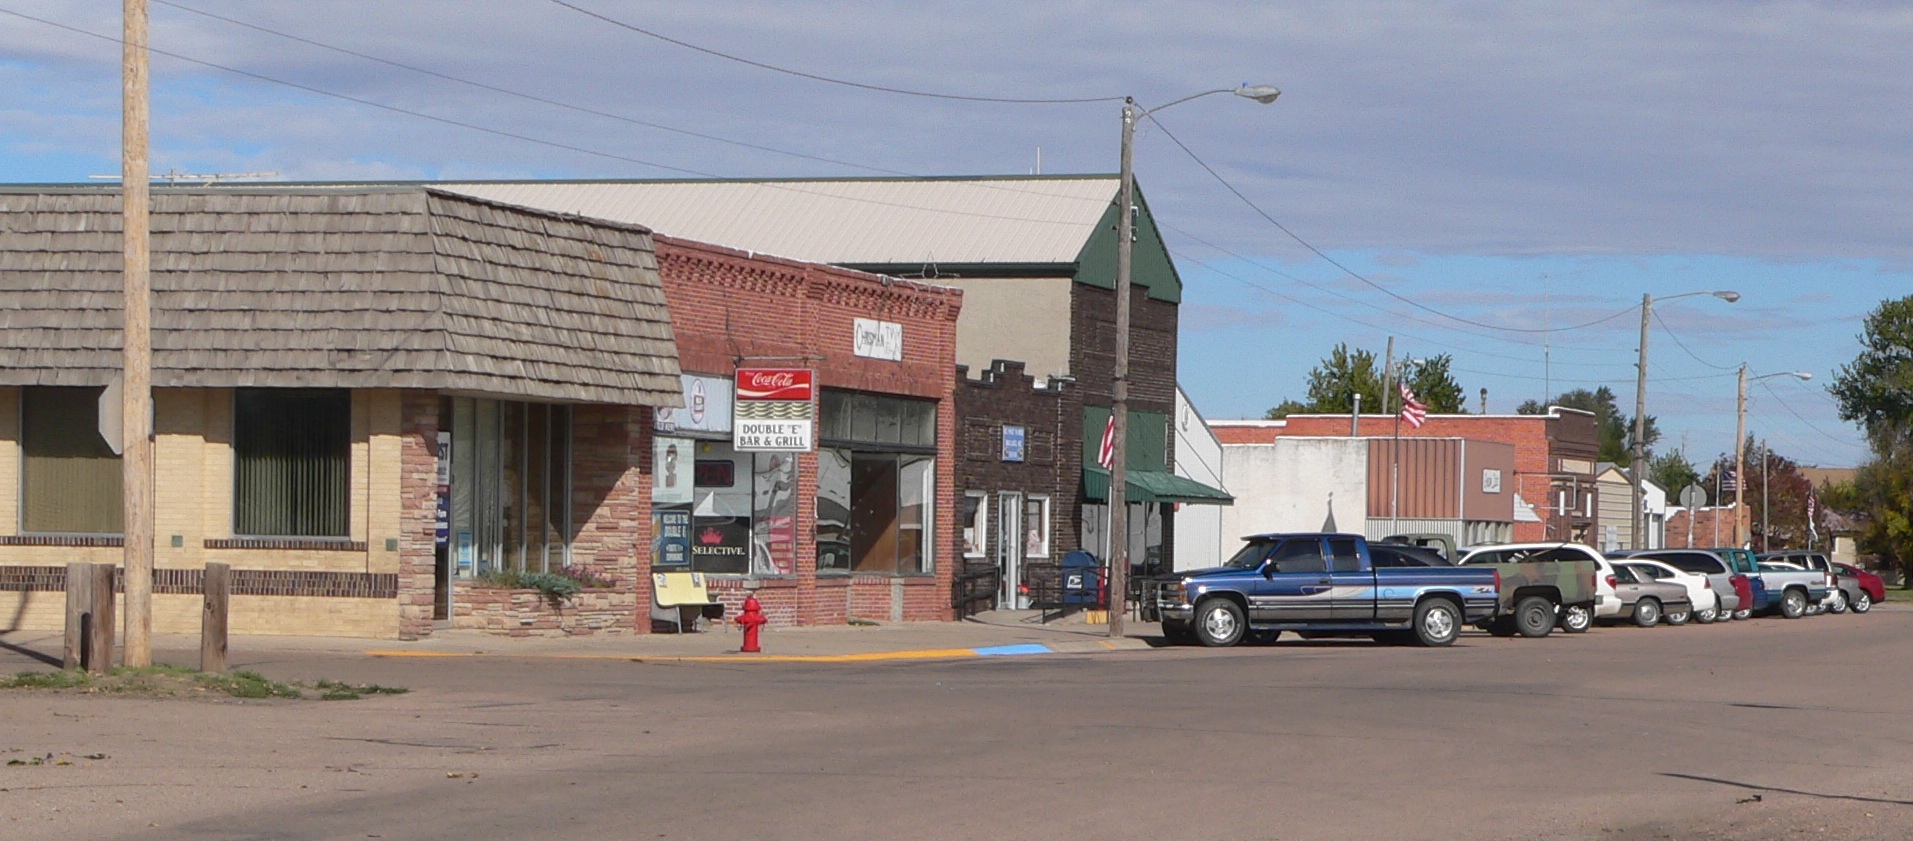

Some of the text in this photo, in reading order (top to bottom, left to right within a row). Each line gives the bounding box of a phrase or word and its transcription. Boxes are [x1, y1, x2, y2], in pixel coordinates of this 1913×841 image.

[743, 424, 802, 434] DOUBLE "E"
[740, 436, 804, 446] BAR & GRILL
